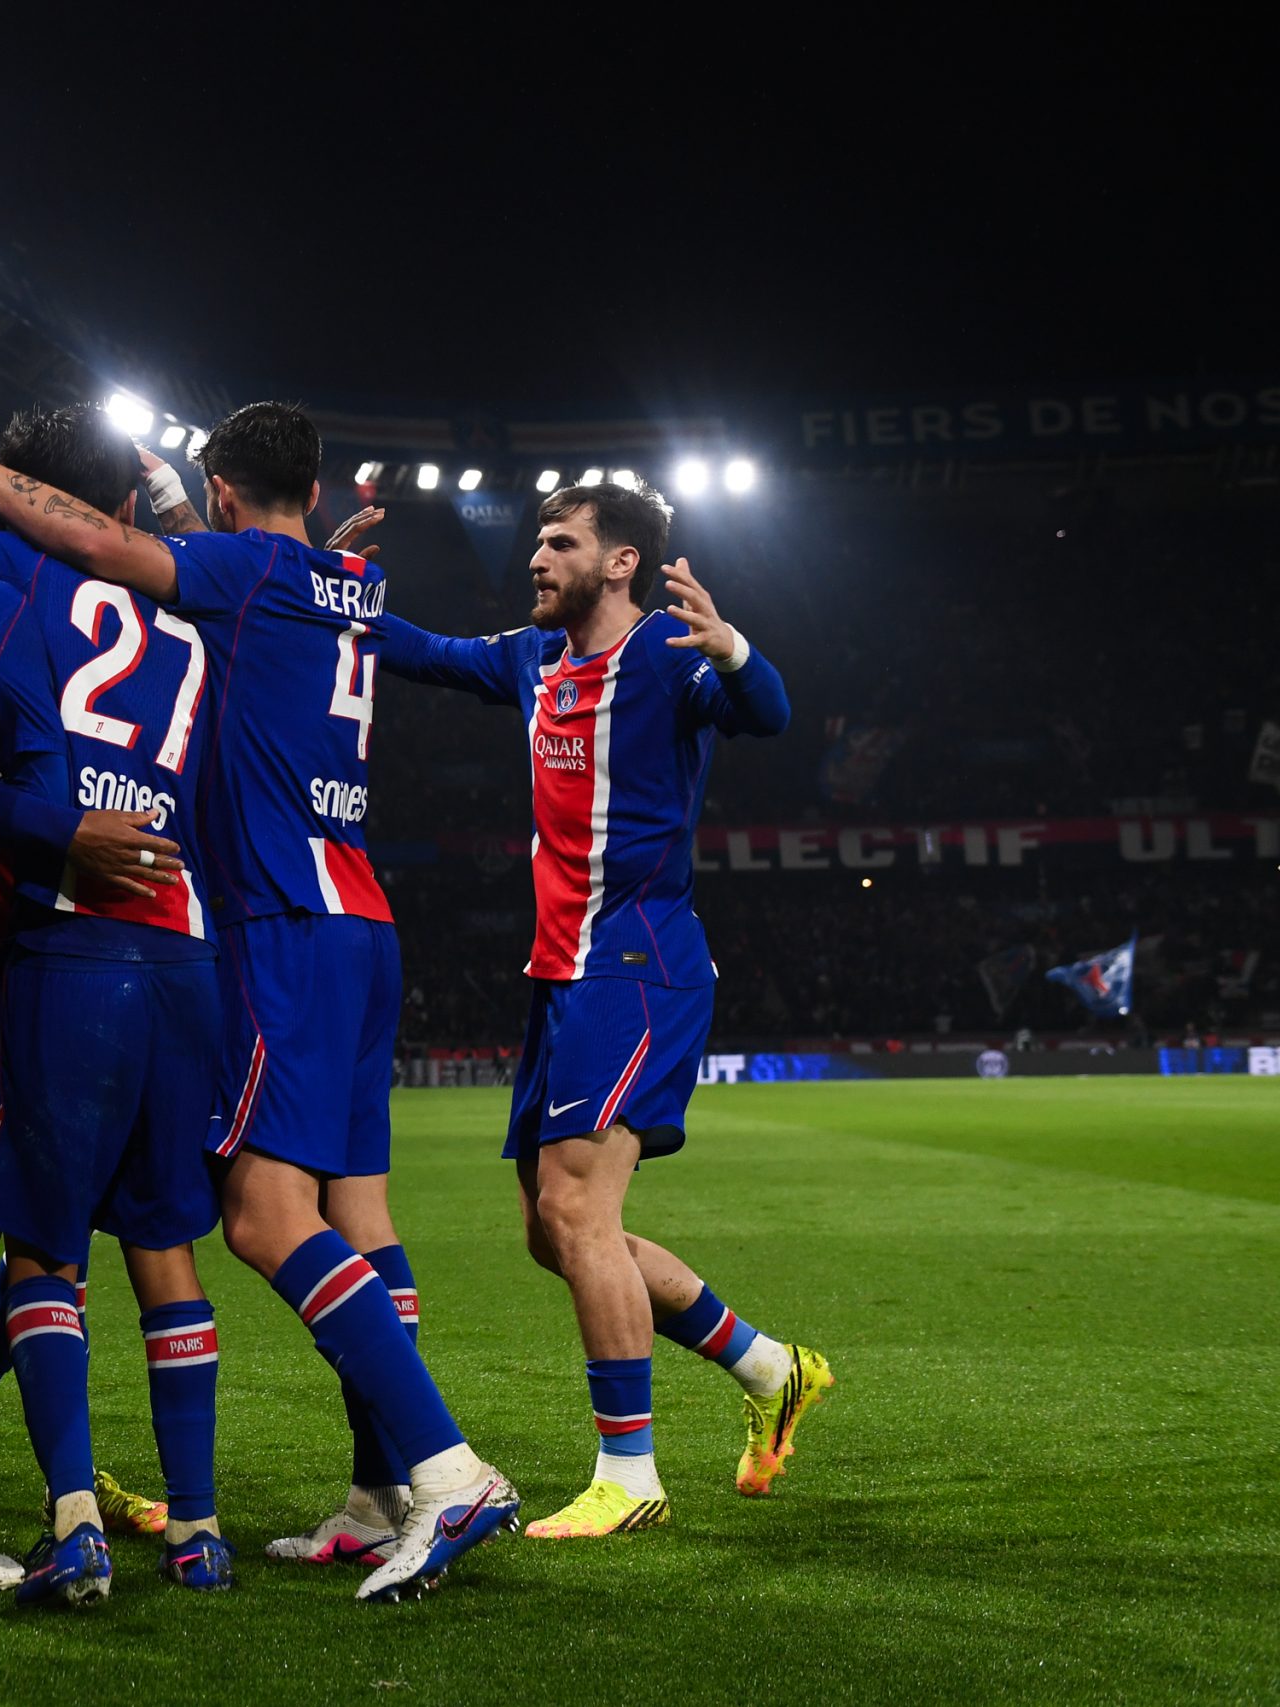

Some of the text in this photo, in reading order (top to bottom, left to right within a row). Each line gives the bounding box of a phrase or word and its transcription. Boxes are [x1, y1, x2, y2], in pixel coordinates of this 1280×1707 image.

[801, 387, 1280, 448] FIERS DE NOS
[310, 570, 387, 619] BERLD
[59, 579, 208, 777] 27
[326, 619, 376, 761] 4
[535, 734, 586, 758] QATAR
[543, 757, 586, 770] AIRWAYS
[310, 777, 368, 828] snipes
[691, 822, 1047, 872] LLECTIF
[697, 1053, 745, 1085] UT
[394, 1299, 415, 1311] ARIS
[170, 1336, 204, 1354] PARIS
